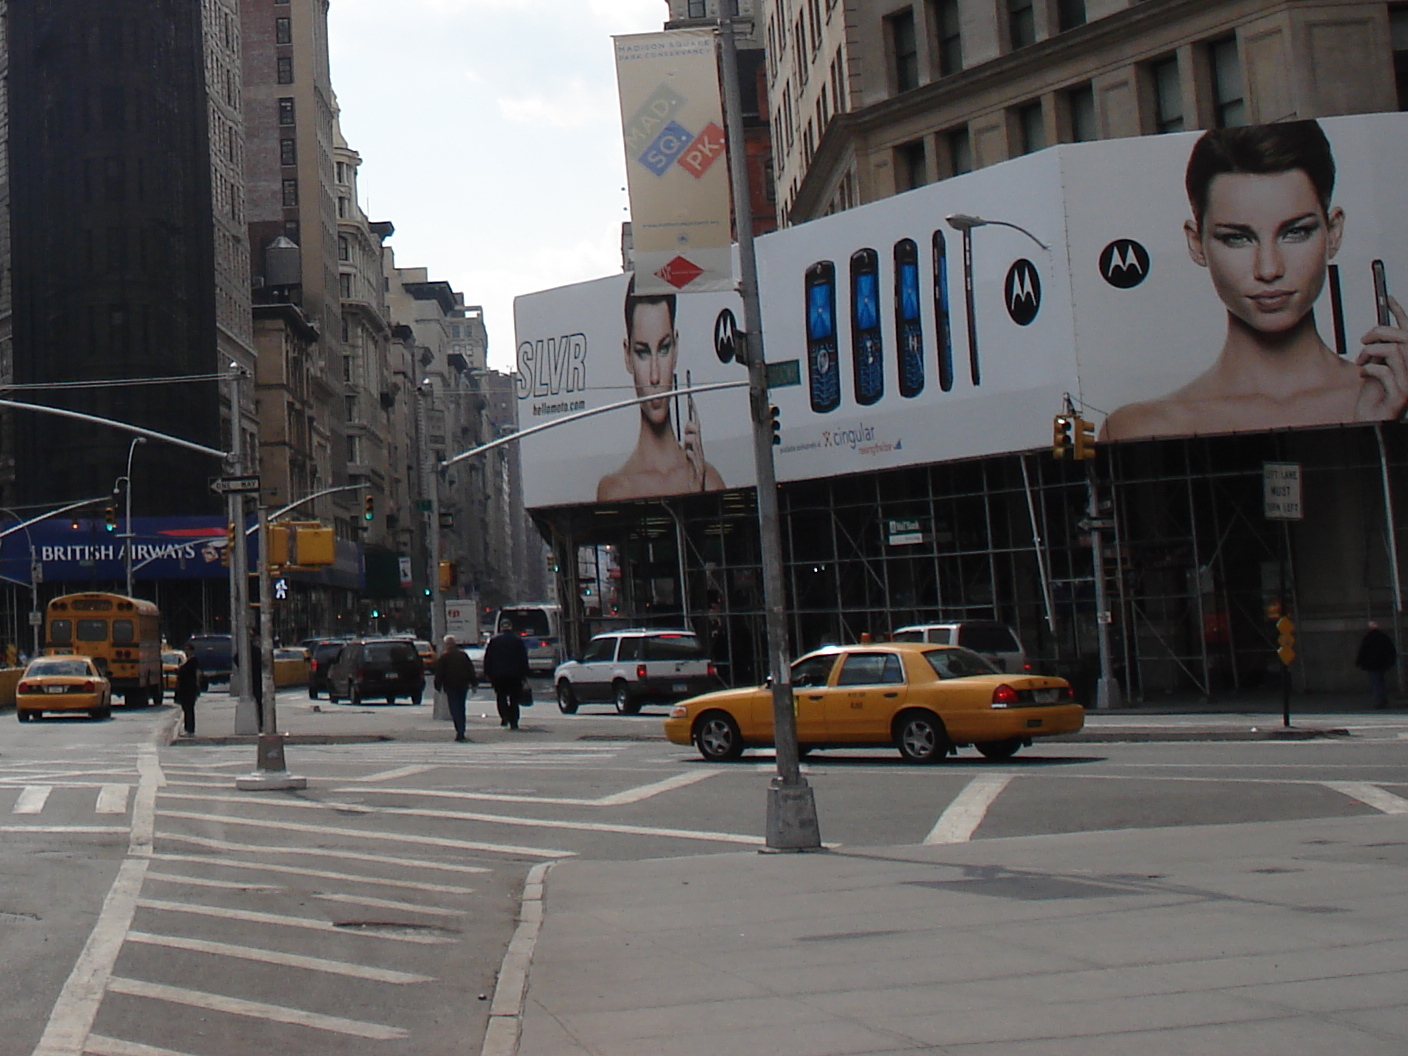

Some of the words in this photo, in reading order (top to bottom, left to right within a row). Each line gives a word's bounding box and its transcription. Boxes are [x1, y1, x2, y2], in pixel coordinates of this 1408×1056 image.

[618, 43, 665, 53] MADISON
[669, 39, 711, 48] SQUARE
[625, 98, 677, 152] MAD.
[647, 134, 687, 169] SQ.
[685, 135, 726, 172] PK.
[517, 332, 587, 400] SLVR
[533, 400, 586, 416] hellomoto.com
[833, 422, 875, 450] cingular
[241, 480, 257, 488] WAY
[42, 544, 114, 562] BRITISH
[117, 543, 196, 561] AIRWAYS
